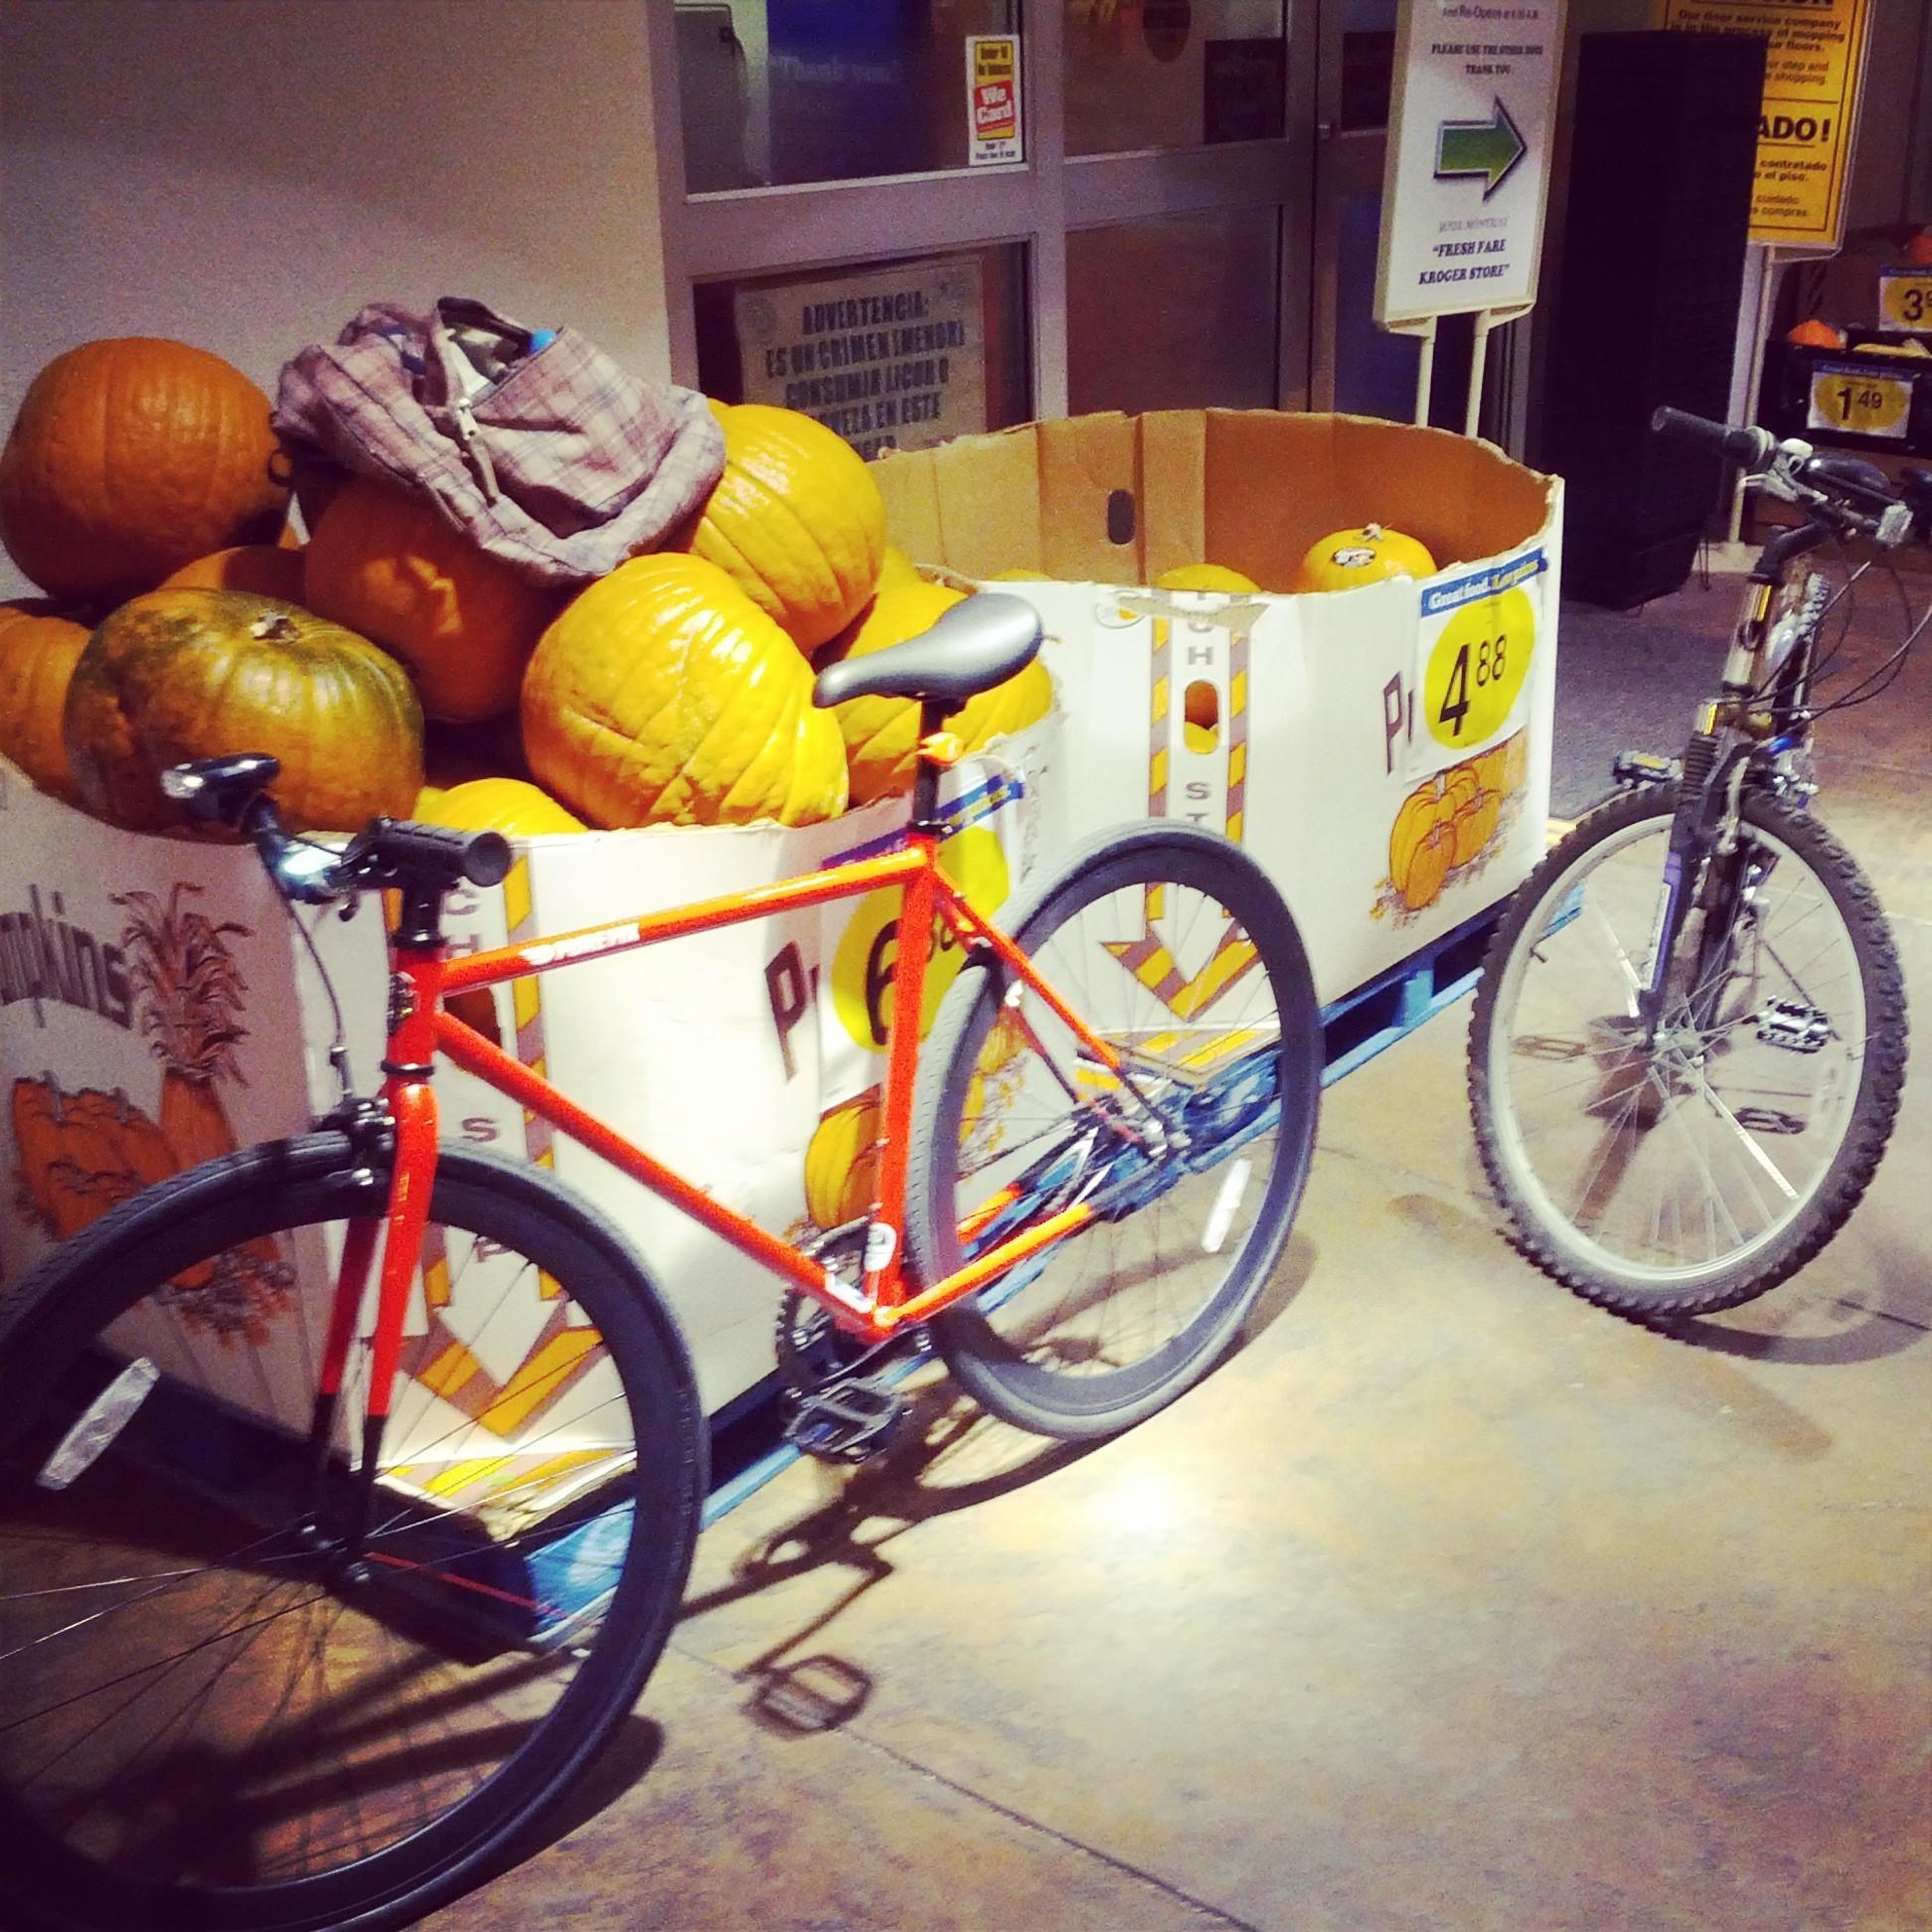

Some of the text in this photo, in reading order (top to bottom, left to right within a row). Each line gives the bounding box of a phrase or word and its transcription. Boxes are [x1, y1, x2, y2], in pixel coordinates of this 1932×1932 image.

[1785, 18, 1842, 30] company
[1792, 31, 1846, 43] mopping
[1757, 114, 1832, 143] ADO!
[1476, 239, 1508, 253] FARE
[1418, 267, 1468, 285] KROGER
[1427, 586, 1464, 610] Great
